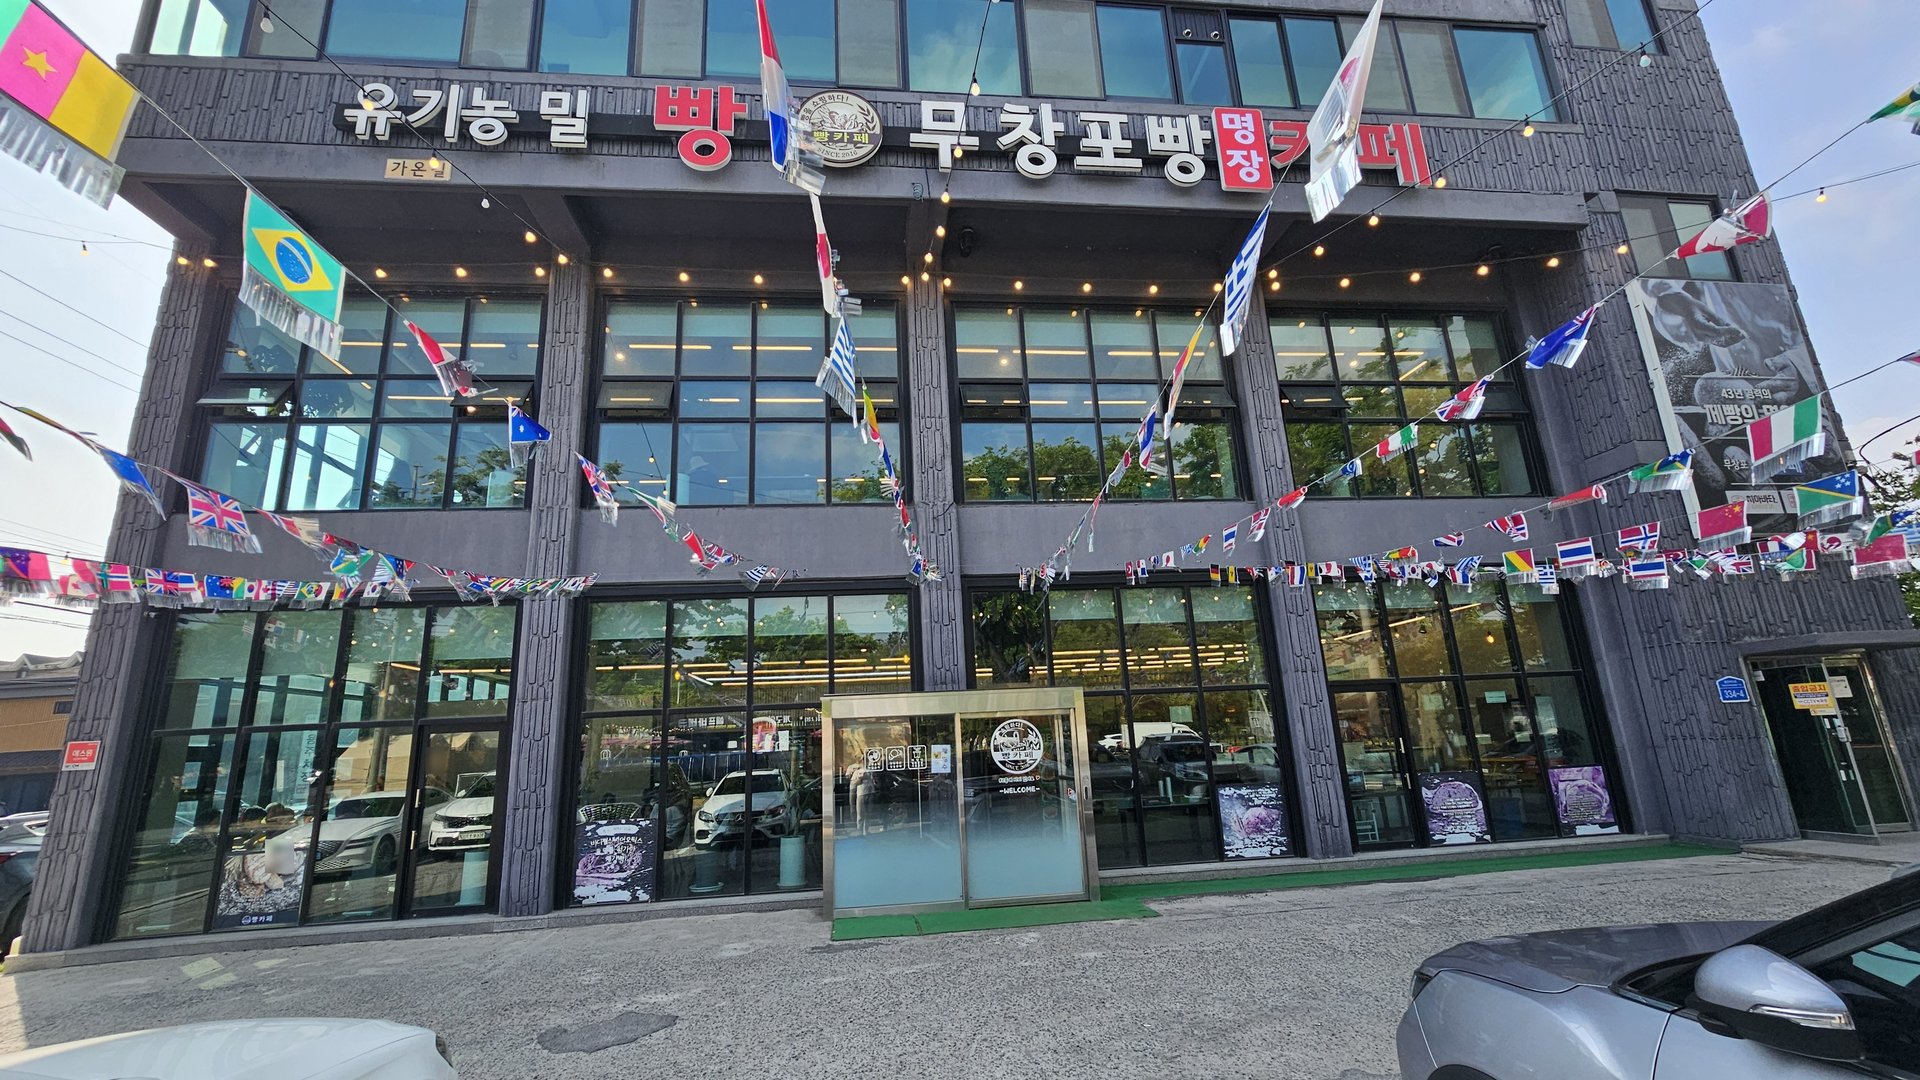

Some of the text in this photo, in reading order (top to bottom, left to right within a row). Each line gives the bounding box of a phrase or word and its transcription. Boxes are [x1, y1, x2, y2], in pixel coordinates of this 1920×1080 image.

[344, 83, 748, 171] 유기농 밀 빵
[813, 131, 869, 144] 빵카페
[909, 100, 1212, 187] 무창포빵
[1221, 113, 1264, 183] 명장
[817, 147, 858, 158] SINCE 2016
[1721, 388, 1744, 399] 43년
[1704, 404, 1760, 425] 제빵의
[1792, 684, 1826, 693] 출입금지
[1723, 690, 1745, 699] 334-4
[1001, 751, 1034, 760] 빵카페
